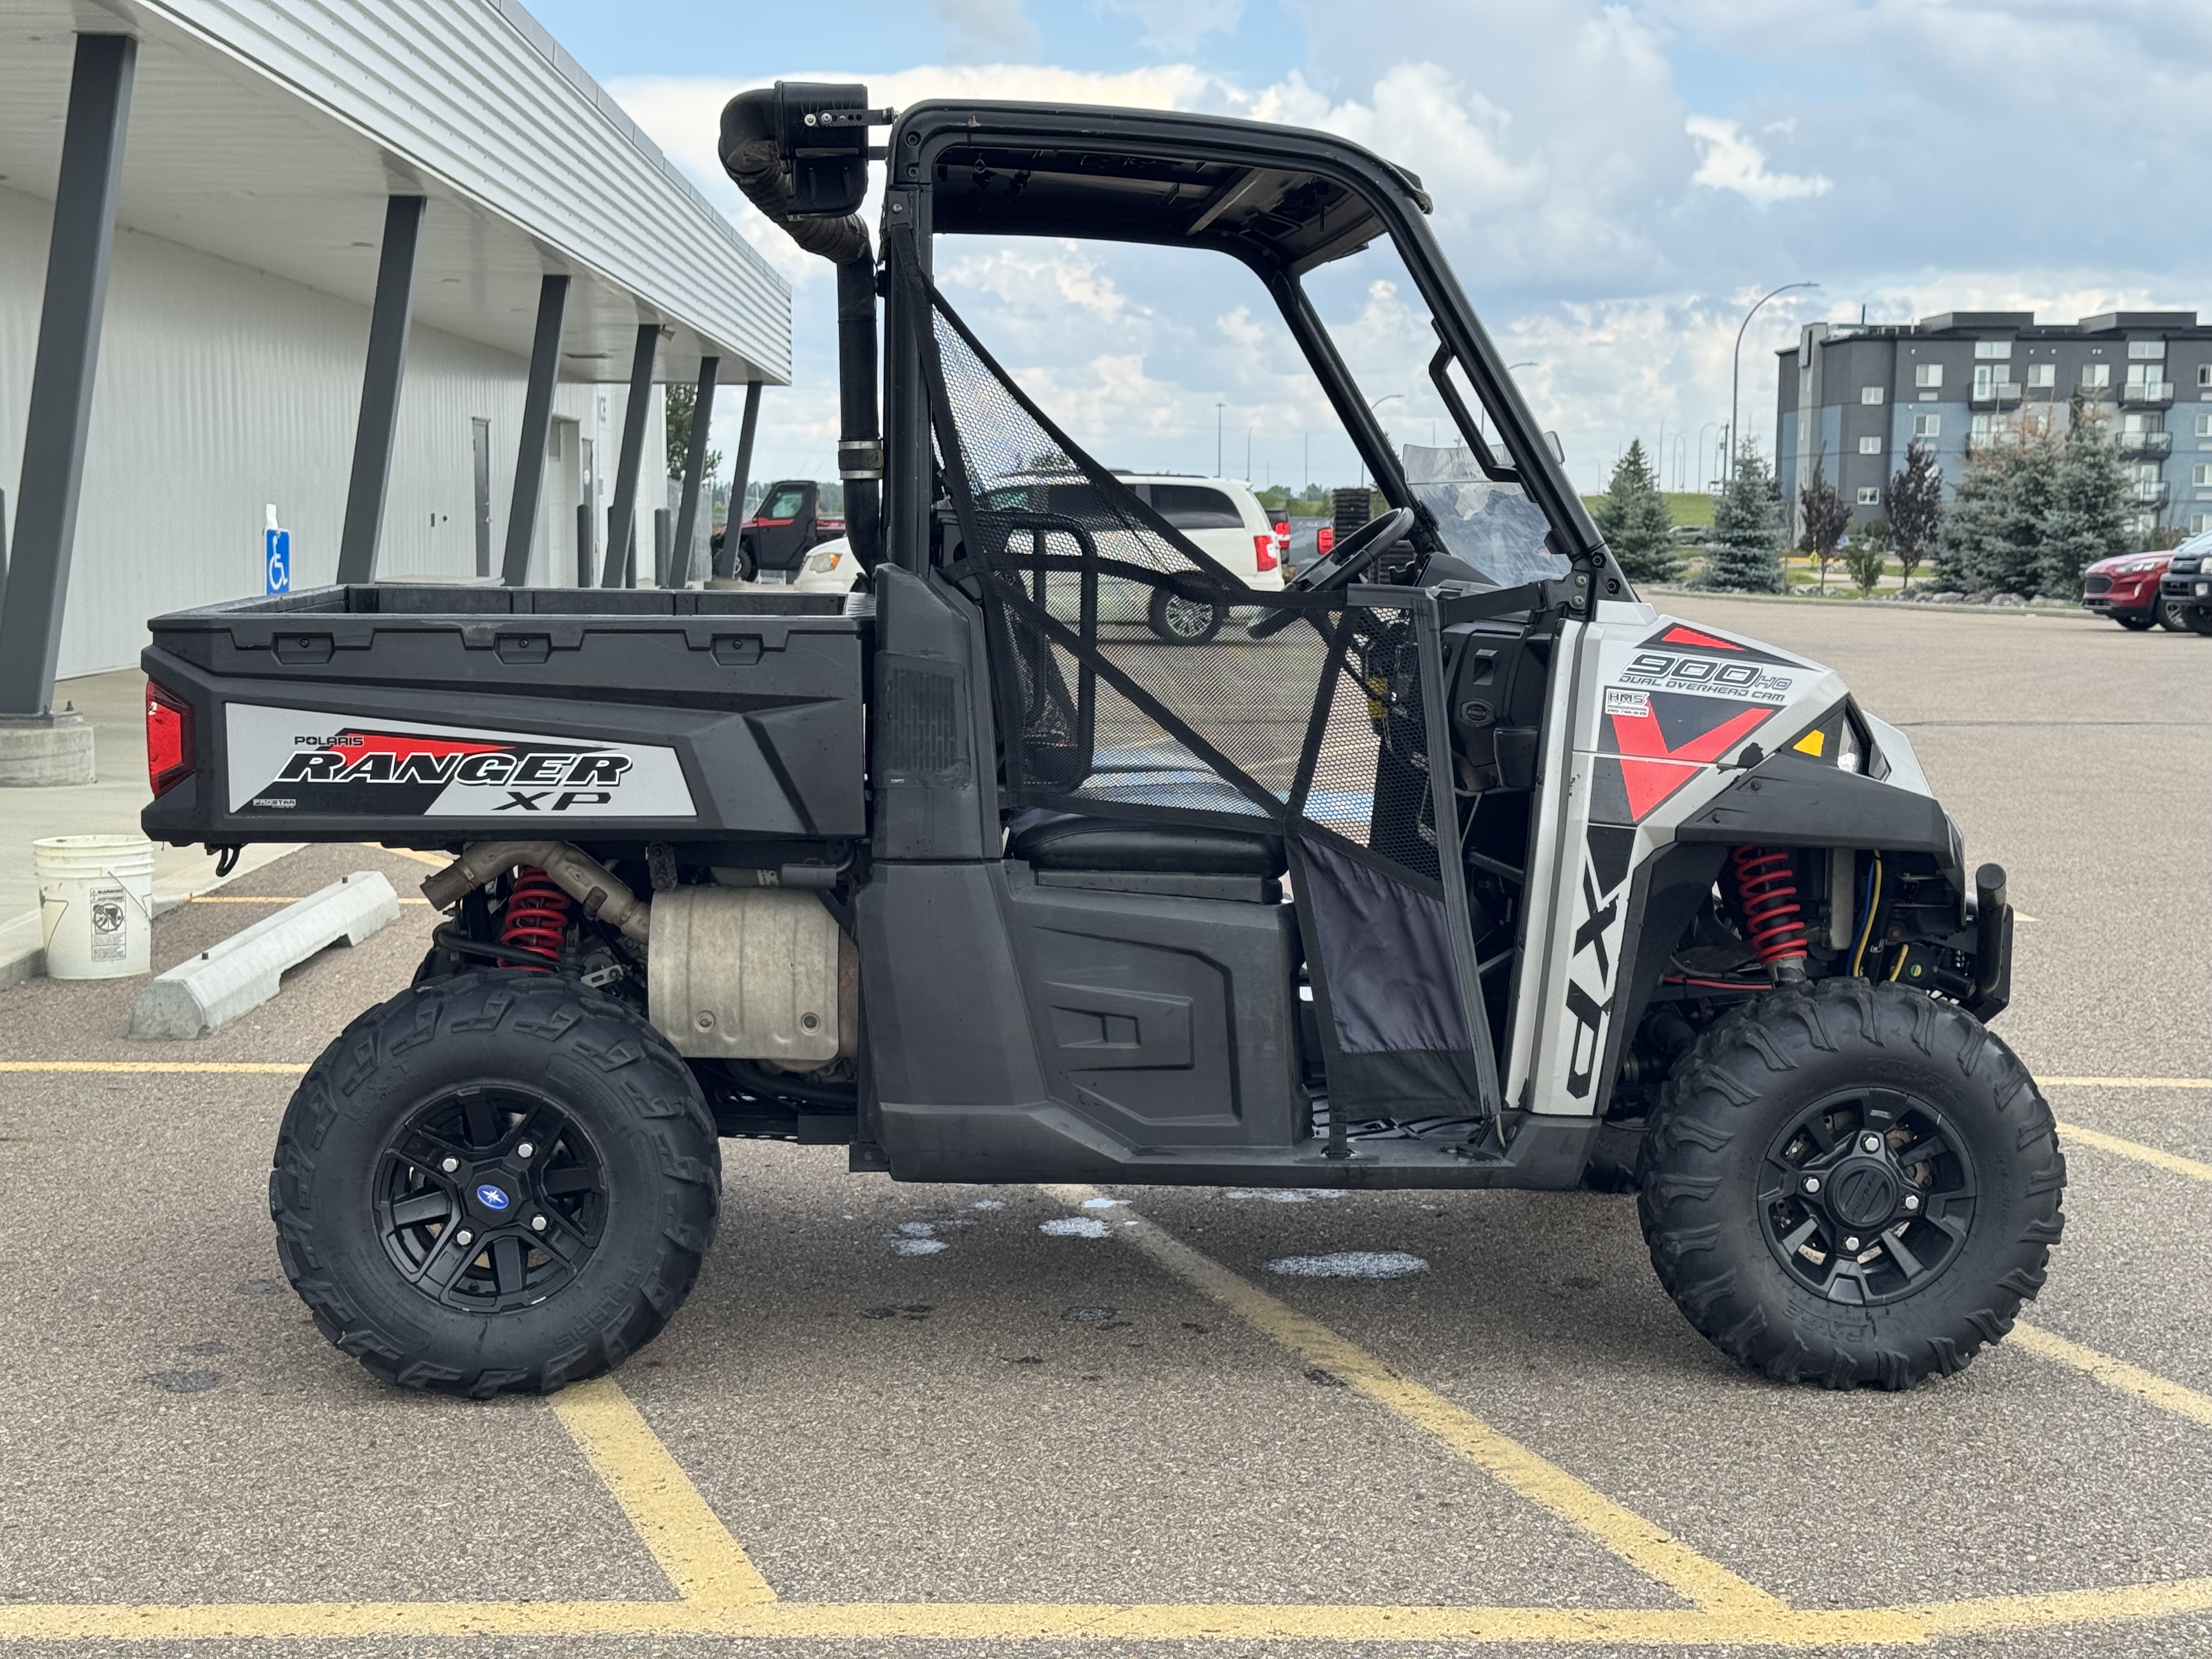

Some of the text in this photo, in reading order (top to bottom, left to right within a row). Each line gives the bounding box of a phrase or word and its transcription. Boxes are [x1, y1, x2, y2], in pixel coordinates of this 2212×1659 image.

[1622, 652, 1763, 687] 900
[1608, 691, 1646, 705] HMS
[1618, 675, 1785, 702] DUAL OVERHEAD CAM
[294, 736, 364, 747] POLARIS
[274, 750, 633, 787] RANGER
[490, 791, 612, 811] XP
[1566, 854, 1620, 1099] XP
